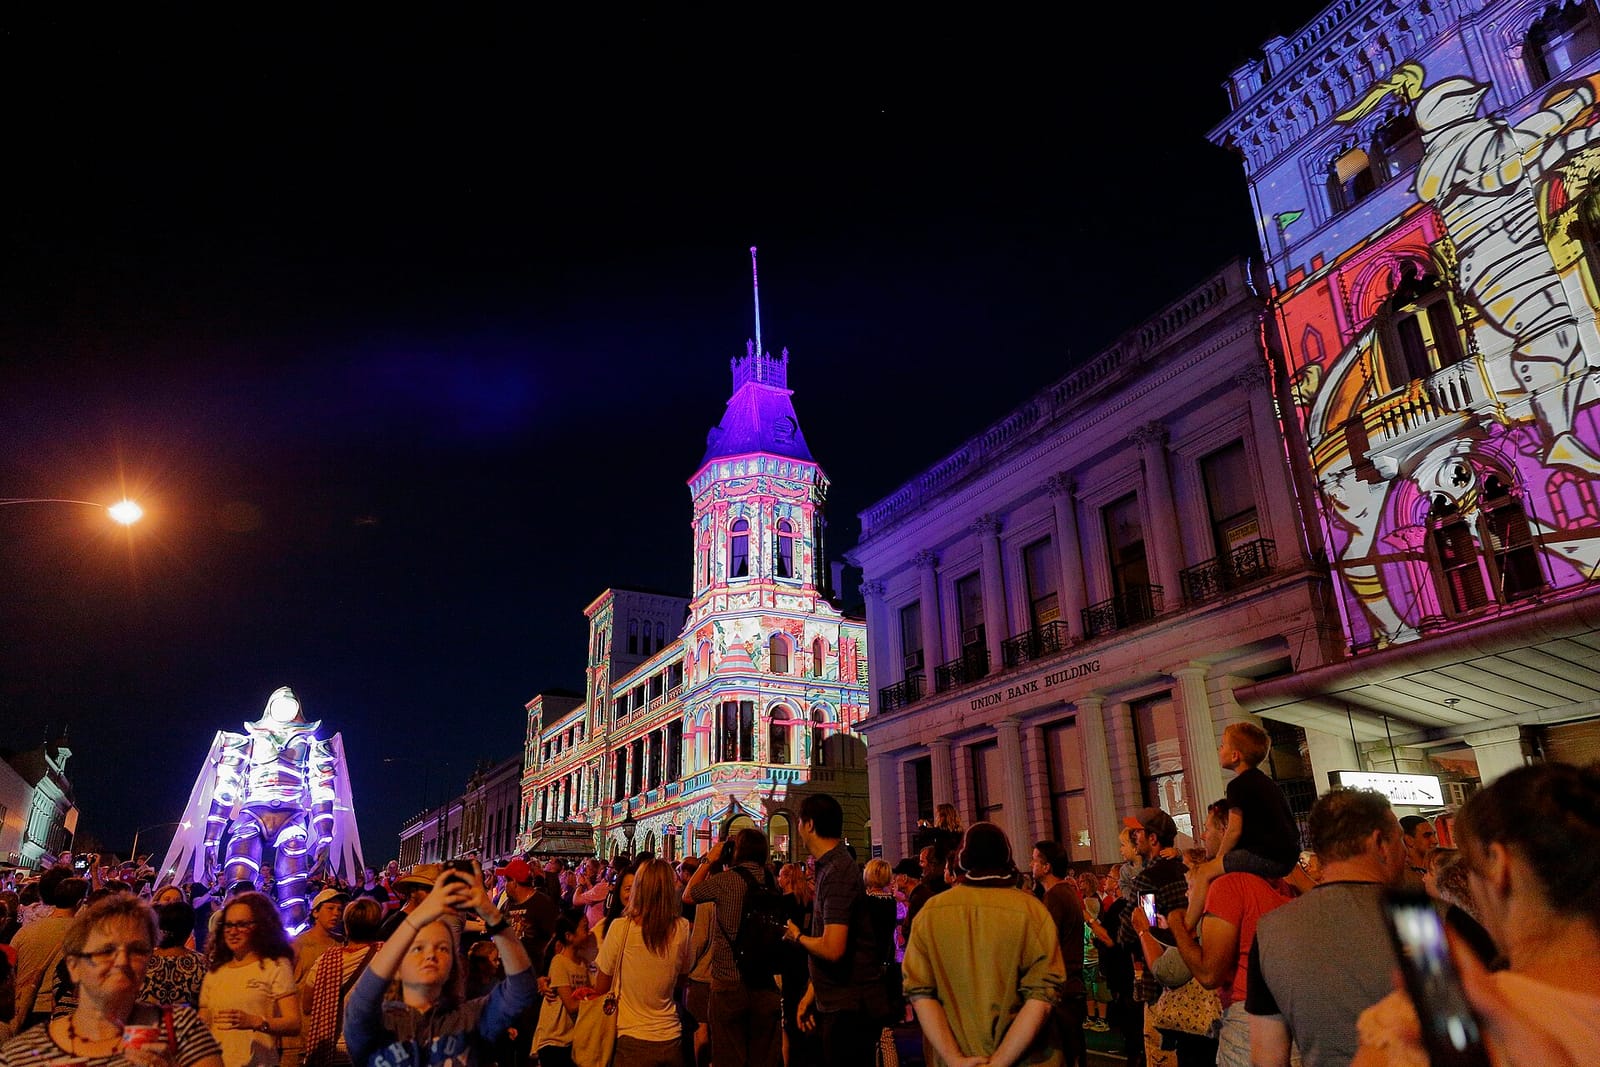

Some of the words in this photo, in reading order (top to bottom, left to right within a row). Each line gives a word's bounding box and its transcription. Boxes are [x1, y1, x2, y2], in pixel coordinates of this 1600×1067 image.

[970, 692, 1002, 711] UNION
[1006, 680, 1038, 700] BANK
[1044, 660, 1100, 688] BUILDING
